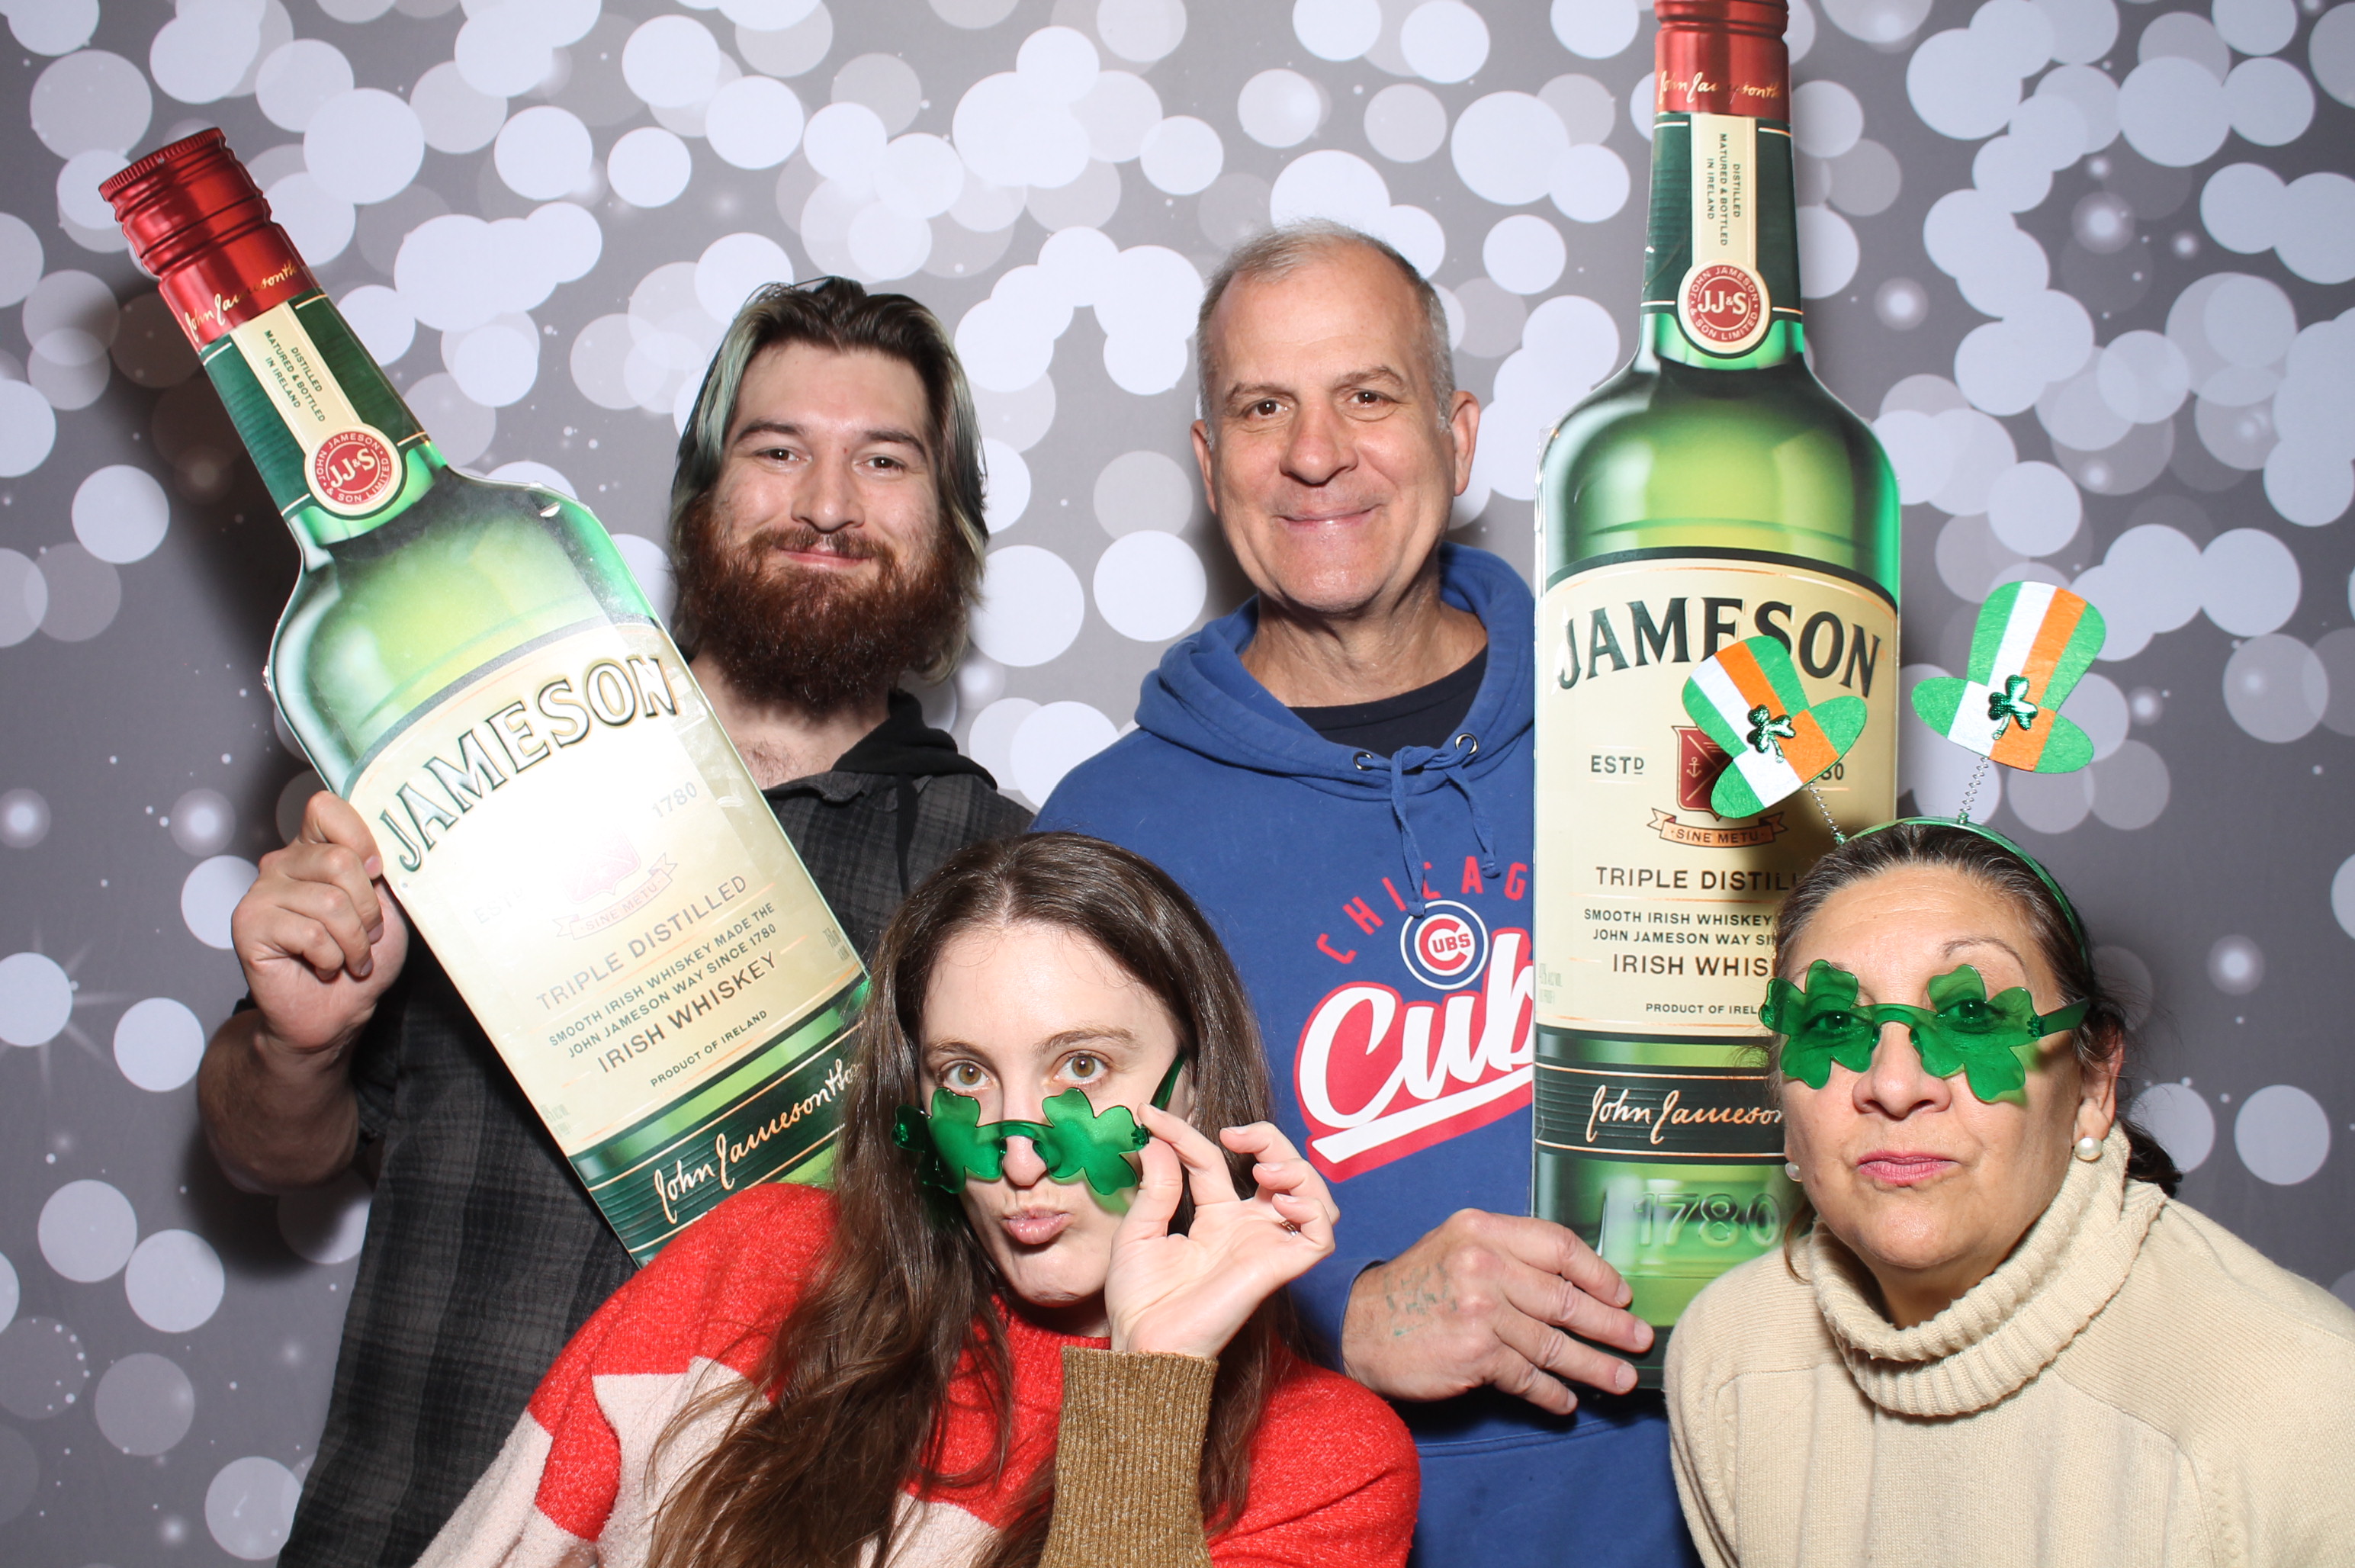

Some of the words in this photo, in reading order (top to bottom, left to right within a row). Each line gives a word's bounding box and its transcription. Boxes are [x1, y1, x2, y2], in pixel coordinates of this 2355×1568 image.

[1707, 158, 1714, 169] IN
[1719, 133, 1727, 185] MATURED
[1720, 198, 1728, 246] BOTTLED
[1690, 271, 1711, 299] JOHN
[1715, 267, 1759, 301] JAMESON
[1697, 290, 1747, 315] JJ&S
[1695, 319, 1717, 338] SON
[1721, 312, 1758, 340] LIMITED
[264, 329, 294, 372] MATURED
[297, 381, 326, 422] BOTTLED
[265, 357, 275, 368] IN
[272, 368, 301, 408] IRELAND
[291, 346, 323, 392] DISTILLED
[316, 451, 327, 480] JOHN
[328, 432, 380, 451] JAMESON
[329, 448, 376, 488] JJ&S
[338, 493, 362, 502] SON
[366, 458, 390, 498] LIMITED
[1557, 596, 1881, 699] JAMESON
[379, 657, 679, 872] JAMESON
[1591, 754, 1645, 775] ESTD
[652, 782, 698, 818] 1780
[1677, 828, 1711, 843] SINE
[1718, 833, 1760, 844] METU
[1596, 866, 1688, 889] TRIPLE
[586, 909, 618, 931] SINE
[622, 882, 657, 914] METU
[1584, 908, 1641, 923] SMOOTH
[1648, 912, 1690, 924] IRISH
[1697, 914, 1771, 927] WHISKEY
[536, 953, 624, 1011] TRIPLE
[628, 876, 747, 959] DISTILLED
[1593, 929, 1628, 941] JOHN
[1634, 931, 1709, 944] JAMESON
[1715, 934, 1750, 946] WAY
[549, 1011, 603, 1046] SMOOTH
[605, 985, 644, 1015] IRISH
[646, 943, 712, 989] WHISKEY
[713, 918, 751, 947] MADE
[751, 902, 775, 923] THE
[1613, 953, 1684, 975] IRISH
[1695, 956, 1775, 977] WHIS
[567, 1033, 601, 1058] JOHN
[604, 991, 671, 1037] JAMESON
[673, 969, 703, 995] WAY
[707, 942, 749, 974] SINCE
[749, 923, 776, 946] 1780
[597, 1023, 666, 1074] IRISH
[667, 950, 776, 1030] WHISKEY
[1646, 1003, 1704, 1014] PRODUCT
[1708, 1005, 1724, 1014] OF
[650, 1052, 702, 1087] PRODUCT
[704, 1040, 718, 1054] OF
[721, 1009, 767, 1043] IRELAND
[1586, 1084, 1651, 1143] John
[654, 1159, 715, 1224] John
[1633, 1192, 1781, 1247] 1780
